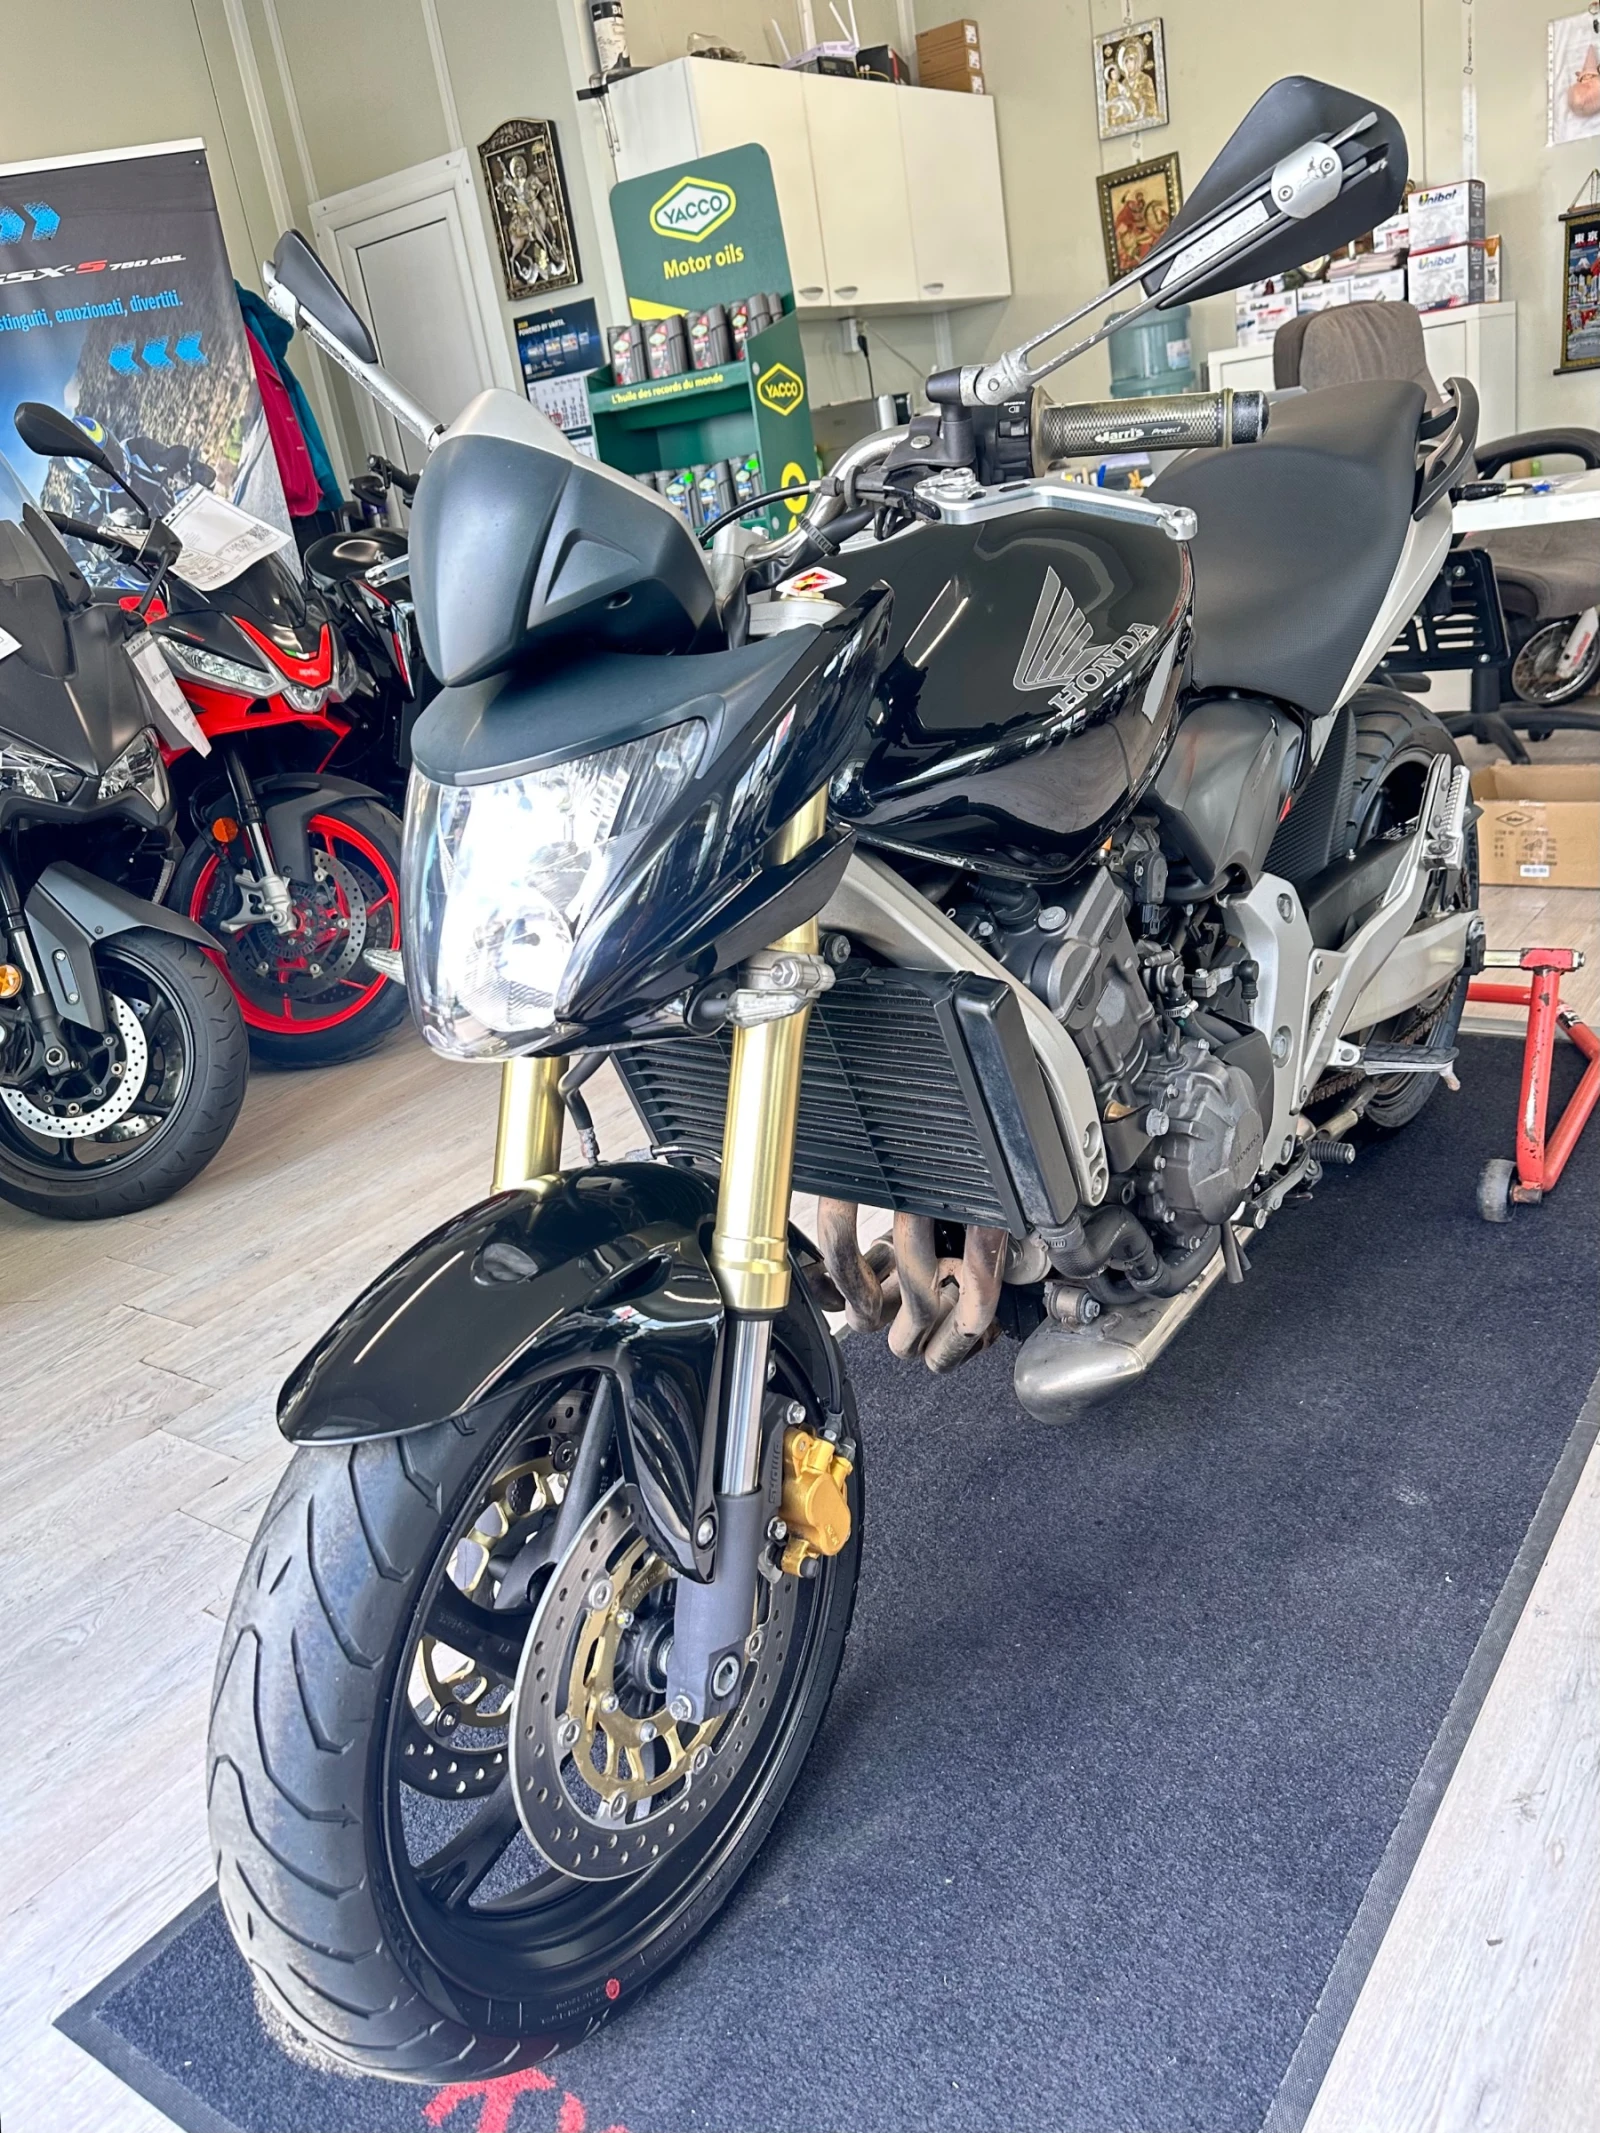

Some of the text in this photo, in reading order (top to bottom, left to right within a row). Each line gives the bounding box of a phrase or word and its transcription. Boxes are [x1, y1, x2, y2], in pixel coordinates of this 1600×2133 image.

[664, 195, 722, 225] YACCO
[1418, 189, 1457, 206] Unibat
[663, 243, 744, 280] Motor oils
[1418, 253, 1457, 270] Unibat
[55, 297, 128, 323] emozionati,
[130, 289, 184, 313] divertiti.
[611, 372, 724, 404] L'huile des records du monde
[765, 382, 798, 399] YACCO
[1151, 426, 1182, 436] Project
[1048, 623, 1159, 717] HONDA
[210, 883, 225, 915] brembo
